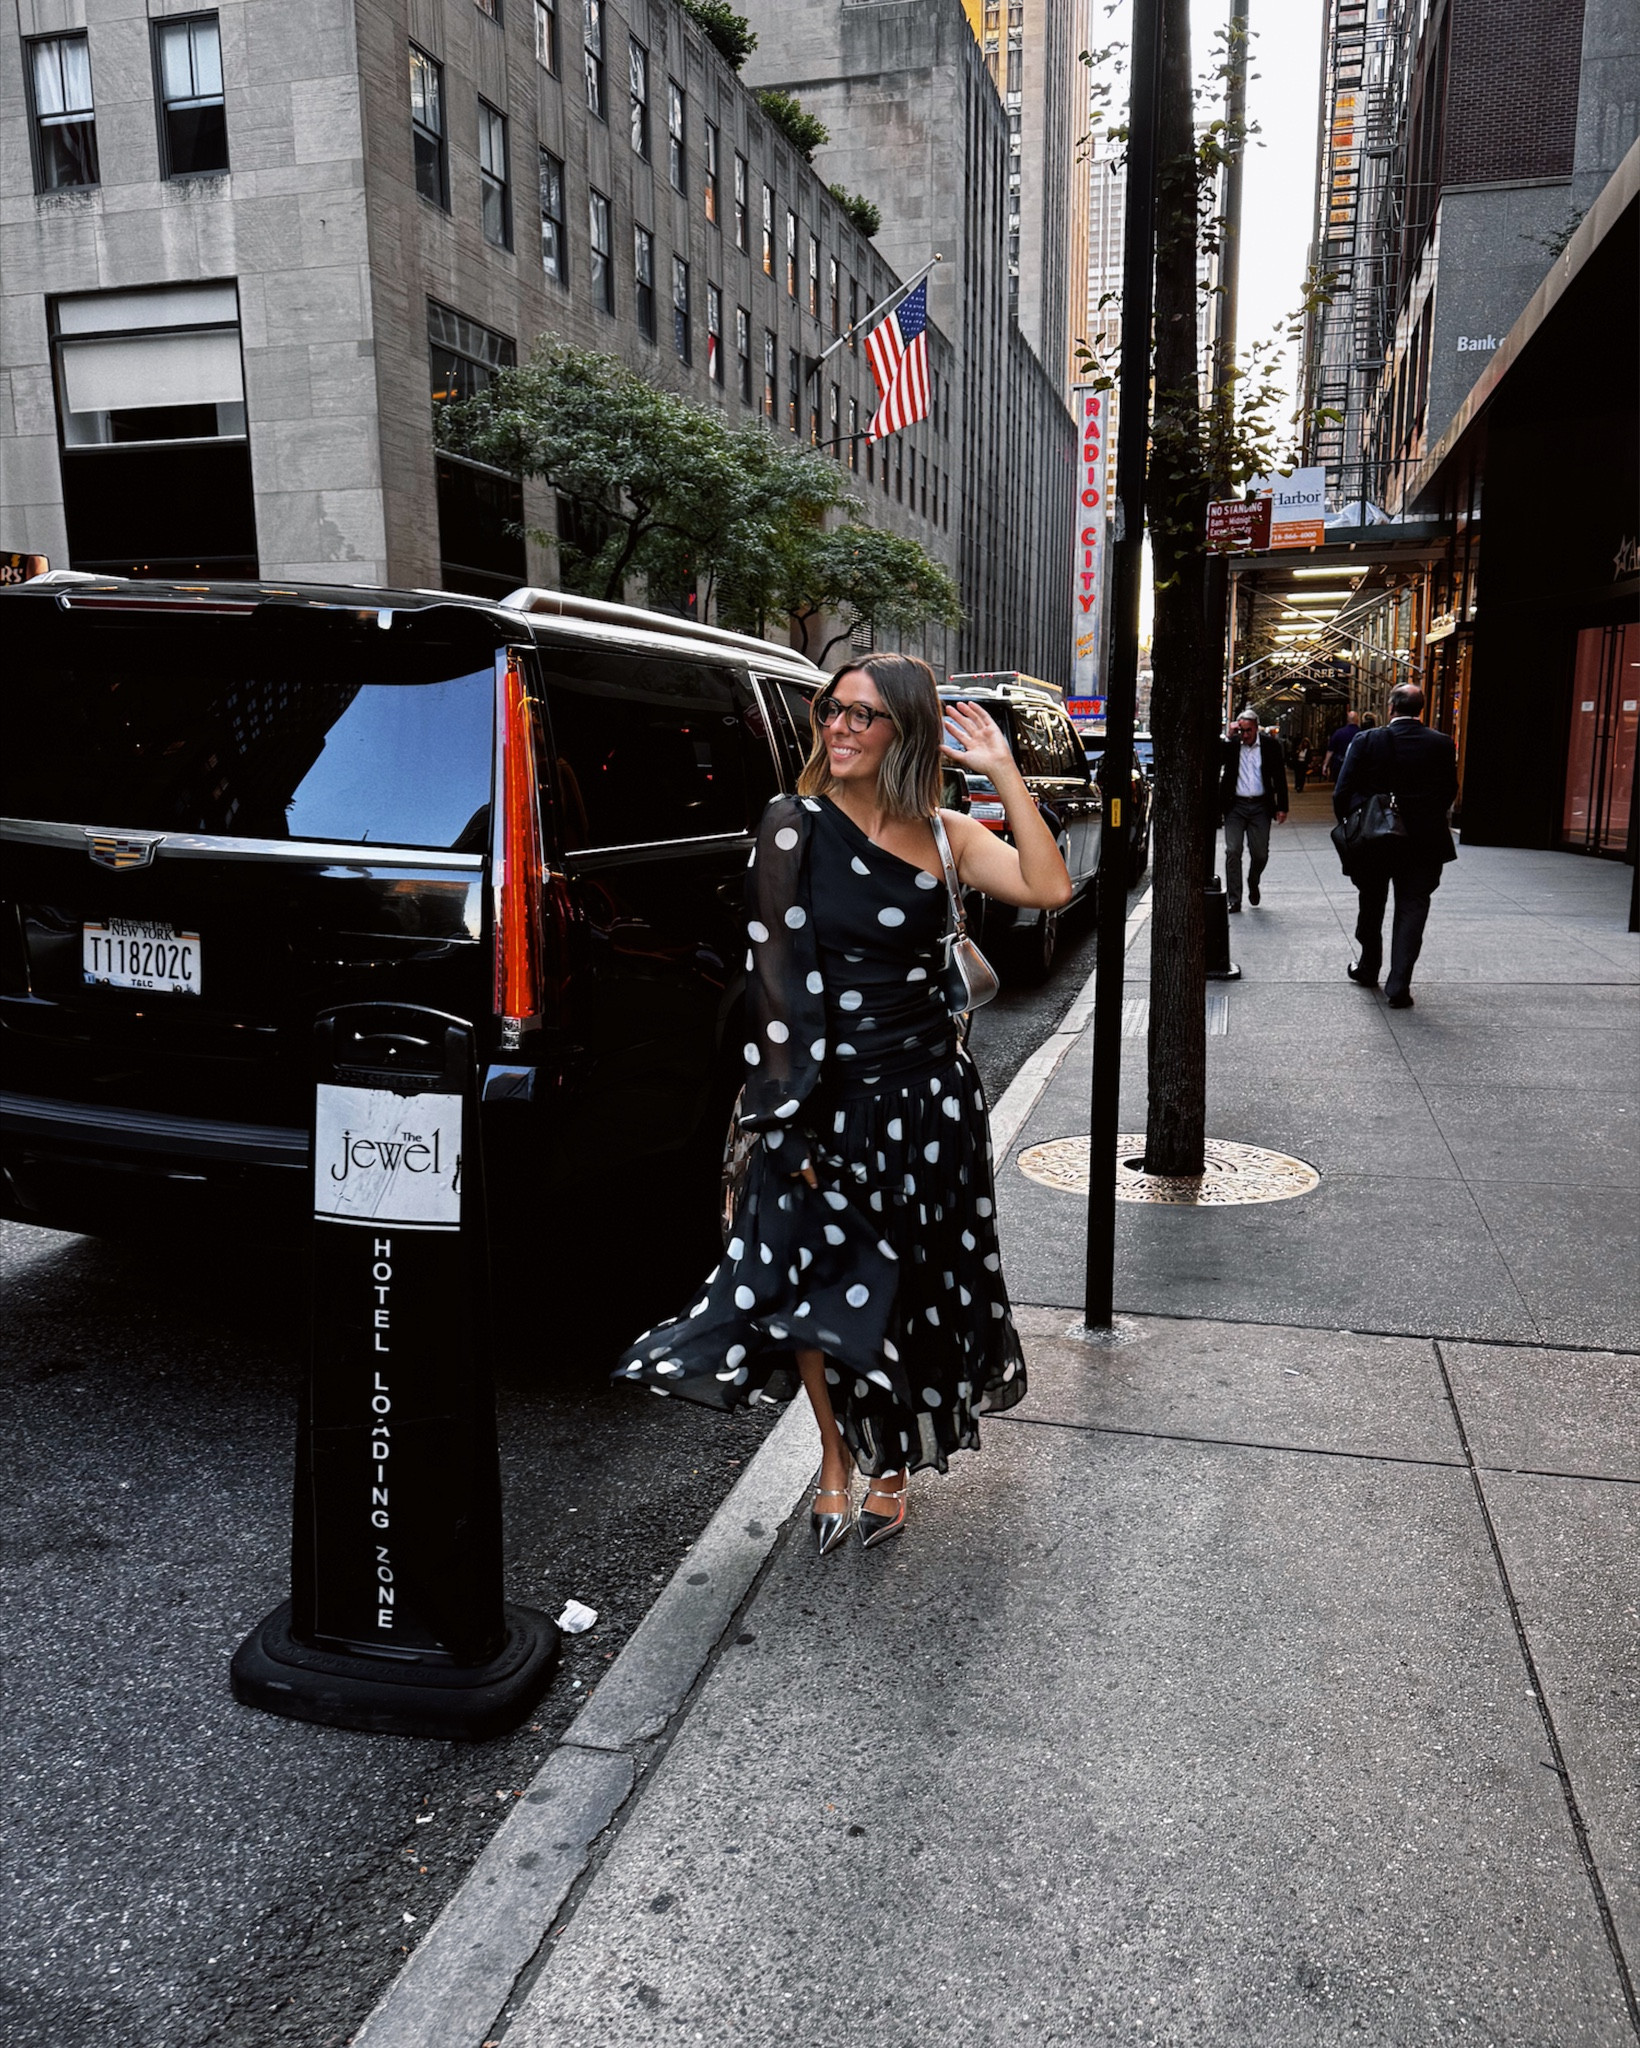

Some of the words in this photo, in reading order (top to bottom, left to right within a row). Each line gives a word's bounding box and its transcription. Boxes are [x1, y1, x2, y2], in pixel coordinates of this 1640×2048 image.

[1457, 334, 1496, 352] Bank
[1081, 398, 1101, 508] RADIO
[1211, 506, 1223, 516] NO
[1224, 502, 1263, 516] STANDING
[1273, 490, 1322, 506] Harbor
[1078, 527, 1097, 613] CITY
[111, 924, 138, 938] NEW
[141, 926, 173, 942] YORK
[90, 937, 192, 981] T118202C
[331, 1128, 441, 1181] jewel
[401, 1132, 423, 1143] The
[372, 1238, 393, 1352] HOTEL
[371, 1371, 393, 1529] LOADING
[375, 1545, 395, 1629] ZONE
